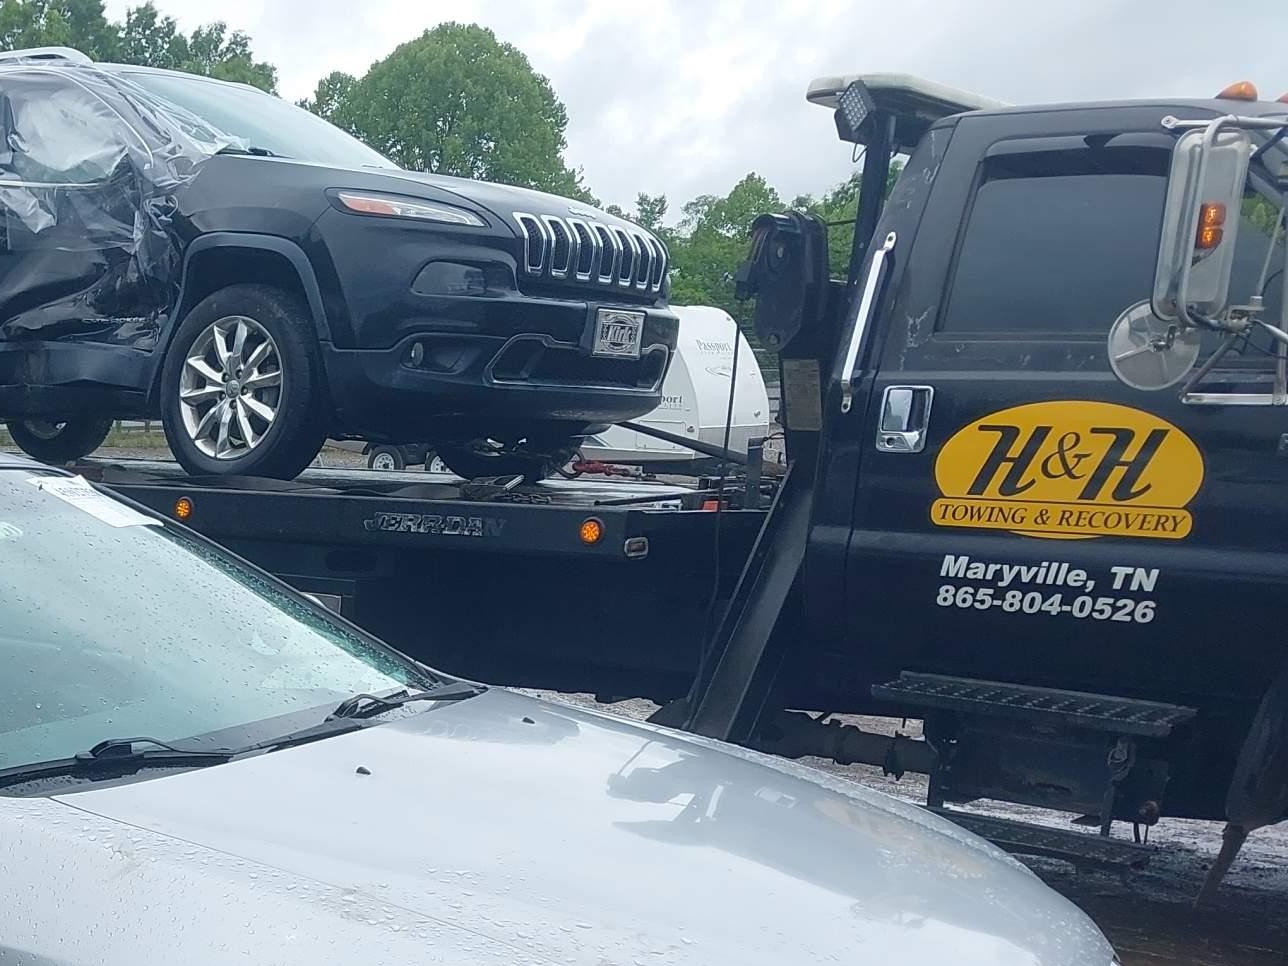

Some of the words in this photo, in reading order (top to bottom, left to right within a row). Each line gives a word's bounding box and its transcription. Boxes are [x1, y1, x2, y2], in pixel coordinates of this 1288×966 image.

[607, 325, 631, 343] Kirk
[967, 424, 1170, 501] H&H
[939, 503, 1028, 525] TOWING
[1033, 508, 1051, 526] &
[1057, 509, 1186, 533] RECOVERY
[940, 555, 1096, 592] Maryville,
[1111, 566, 1159, 592] TN
[936, 585, 1157, 623] 865-804-0526
